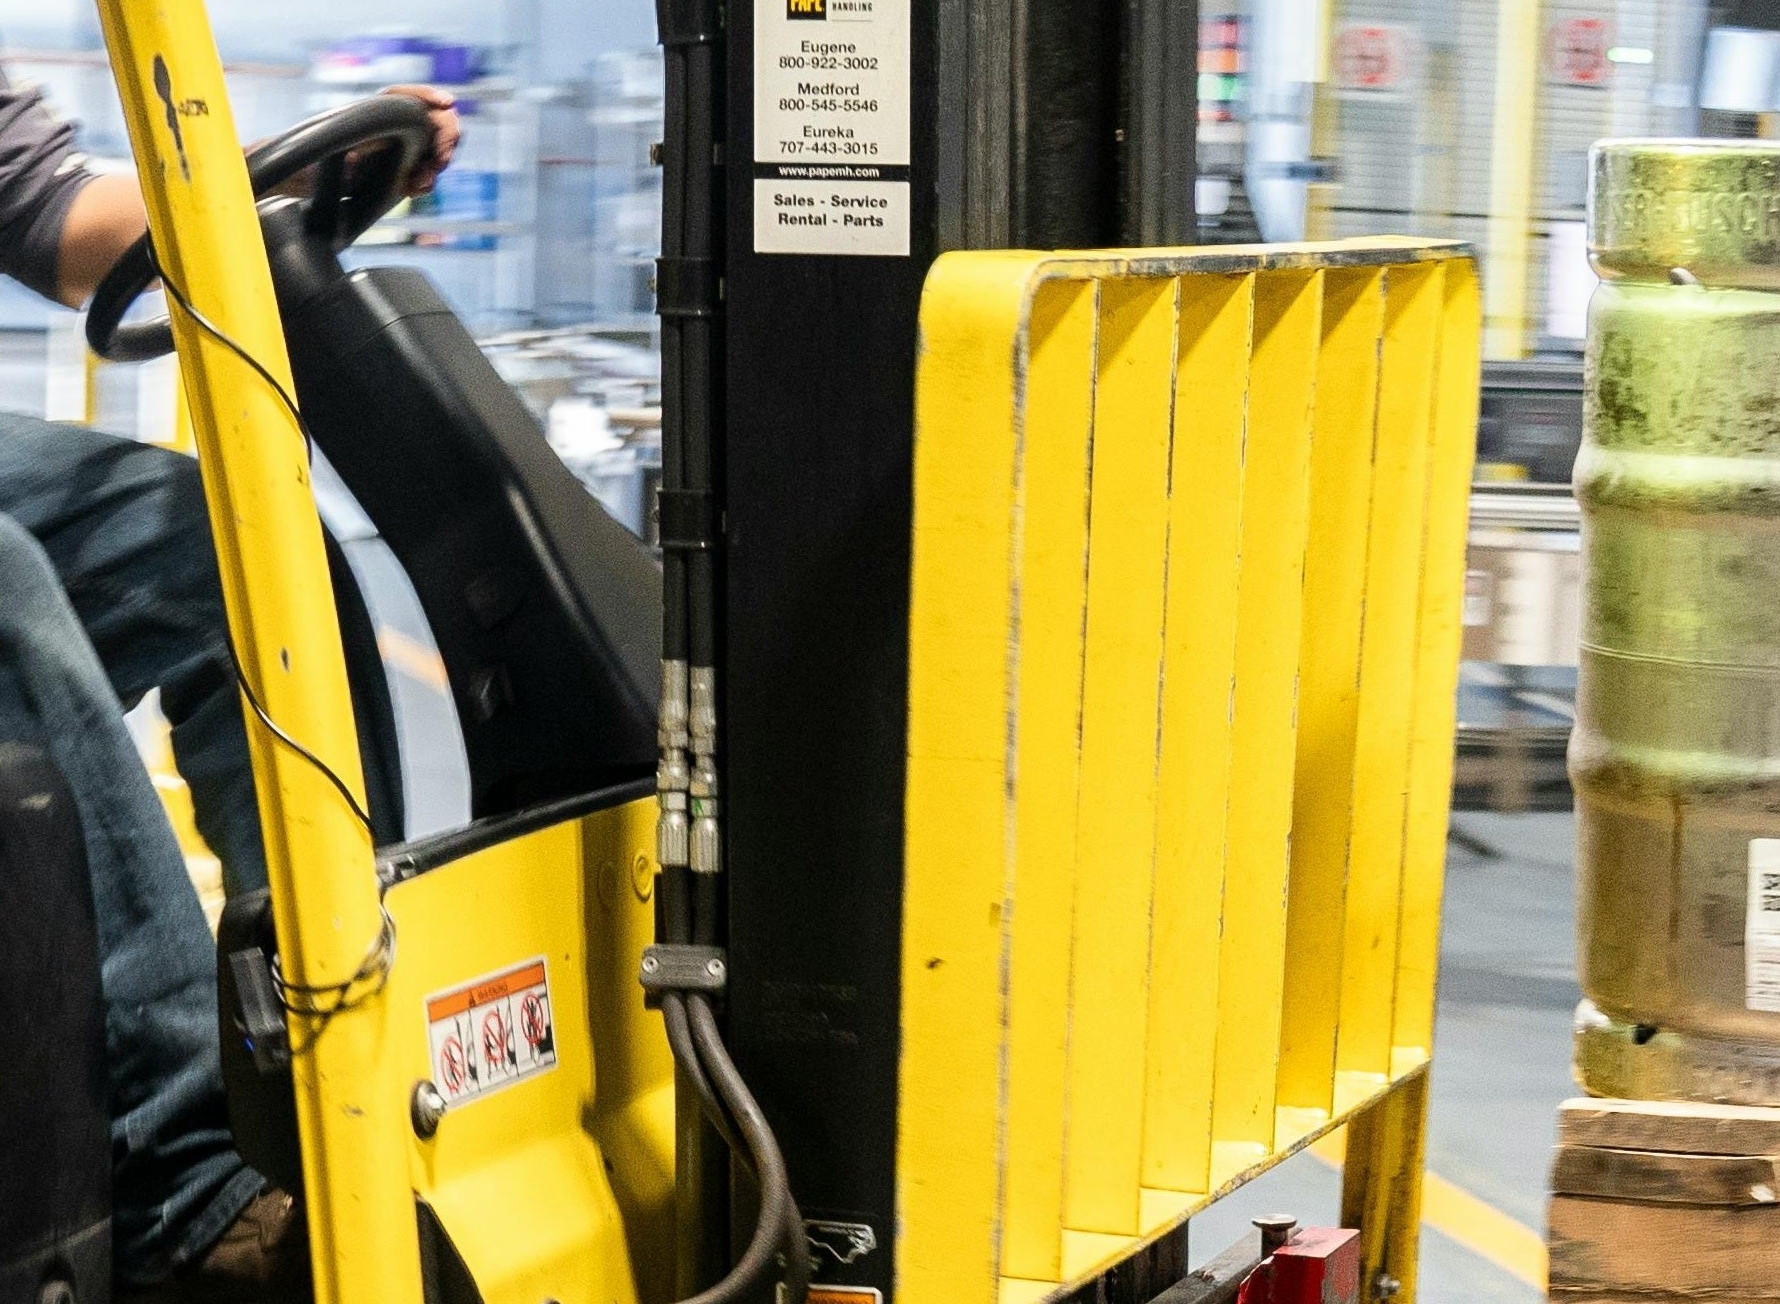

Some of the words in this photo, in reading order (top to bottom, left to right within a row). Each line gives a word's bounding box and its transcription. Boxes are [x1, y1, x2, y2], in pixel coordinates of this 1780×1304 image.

[832, 1, 874, 12] HANDLING
[800, 40, 857, 56] Eugene
[778, 57, 879, 70] 800-922-3002
[797, 83, 860, 96] Medford
[778, 99, 879, 113] 800-545-5546
[803, 126, 855, 139] Eureka
[779, 142, 879, 155] 707-443-3015
[778, 166, 880, 179] www.papemh.com
[773, 194, 815, 207] Sales
[830, 195, 889, 209] Service
[778, 213, 828, 227] Rental
[843, 213, 884, 228] Parts
